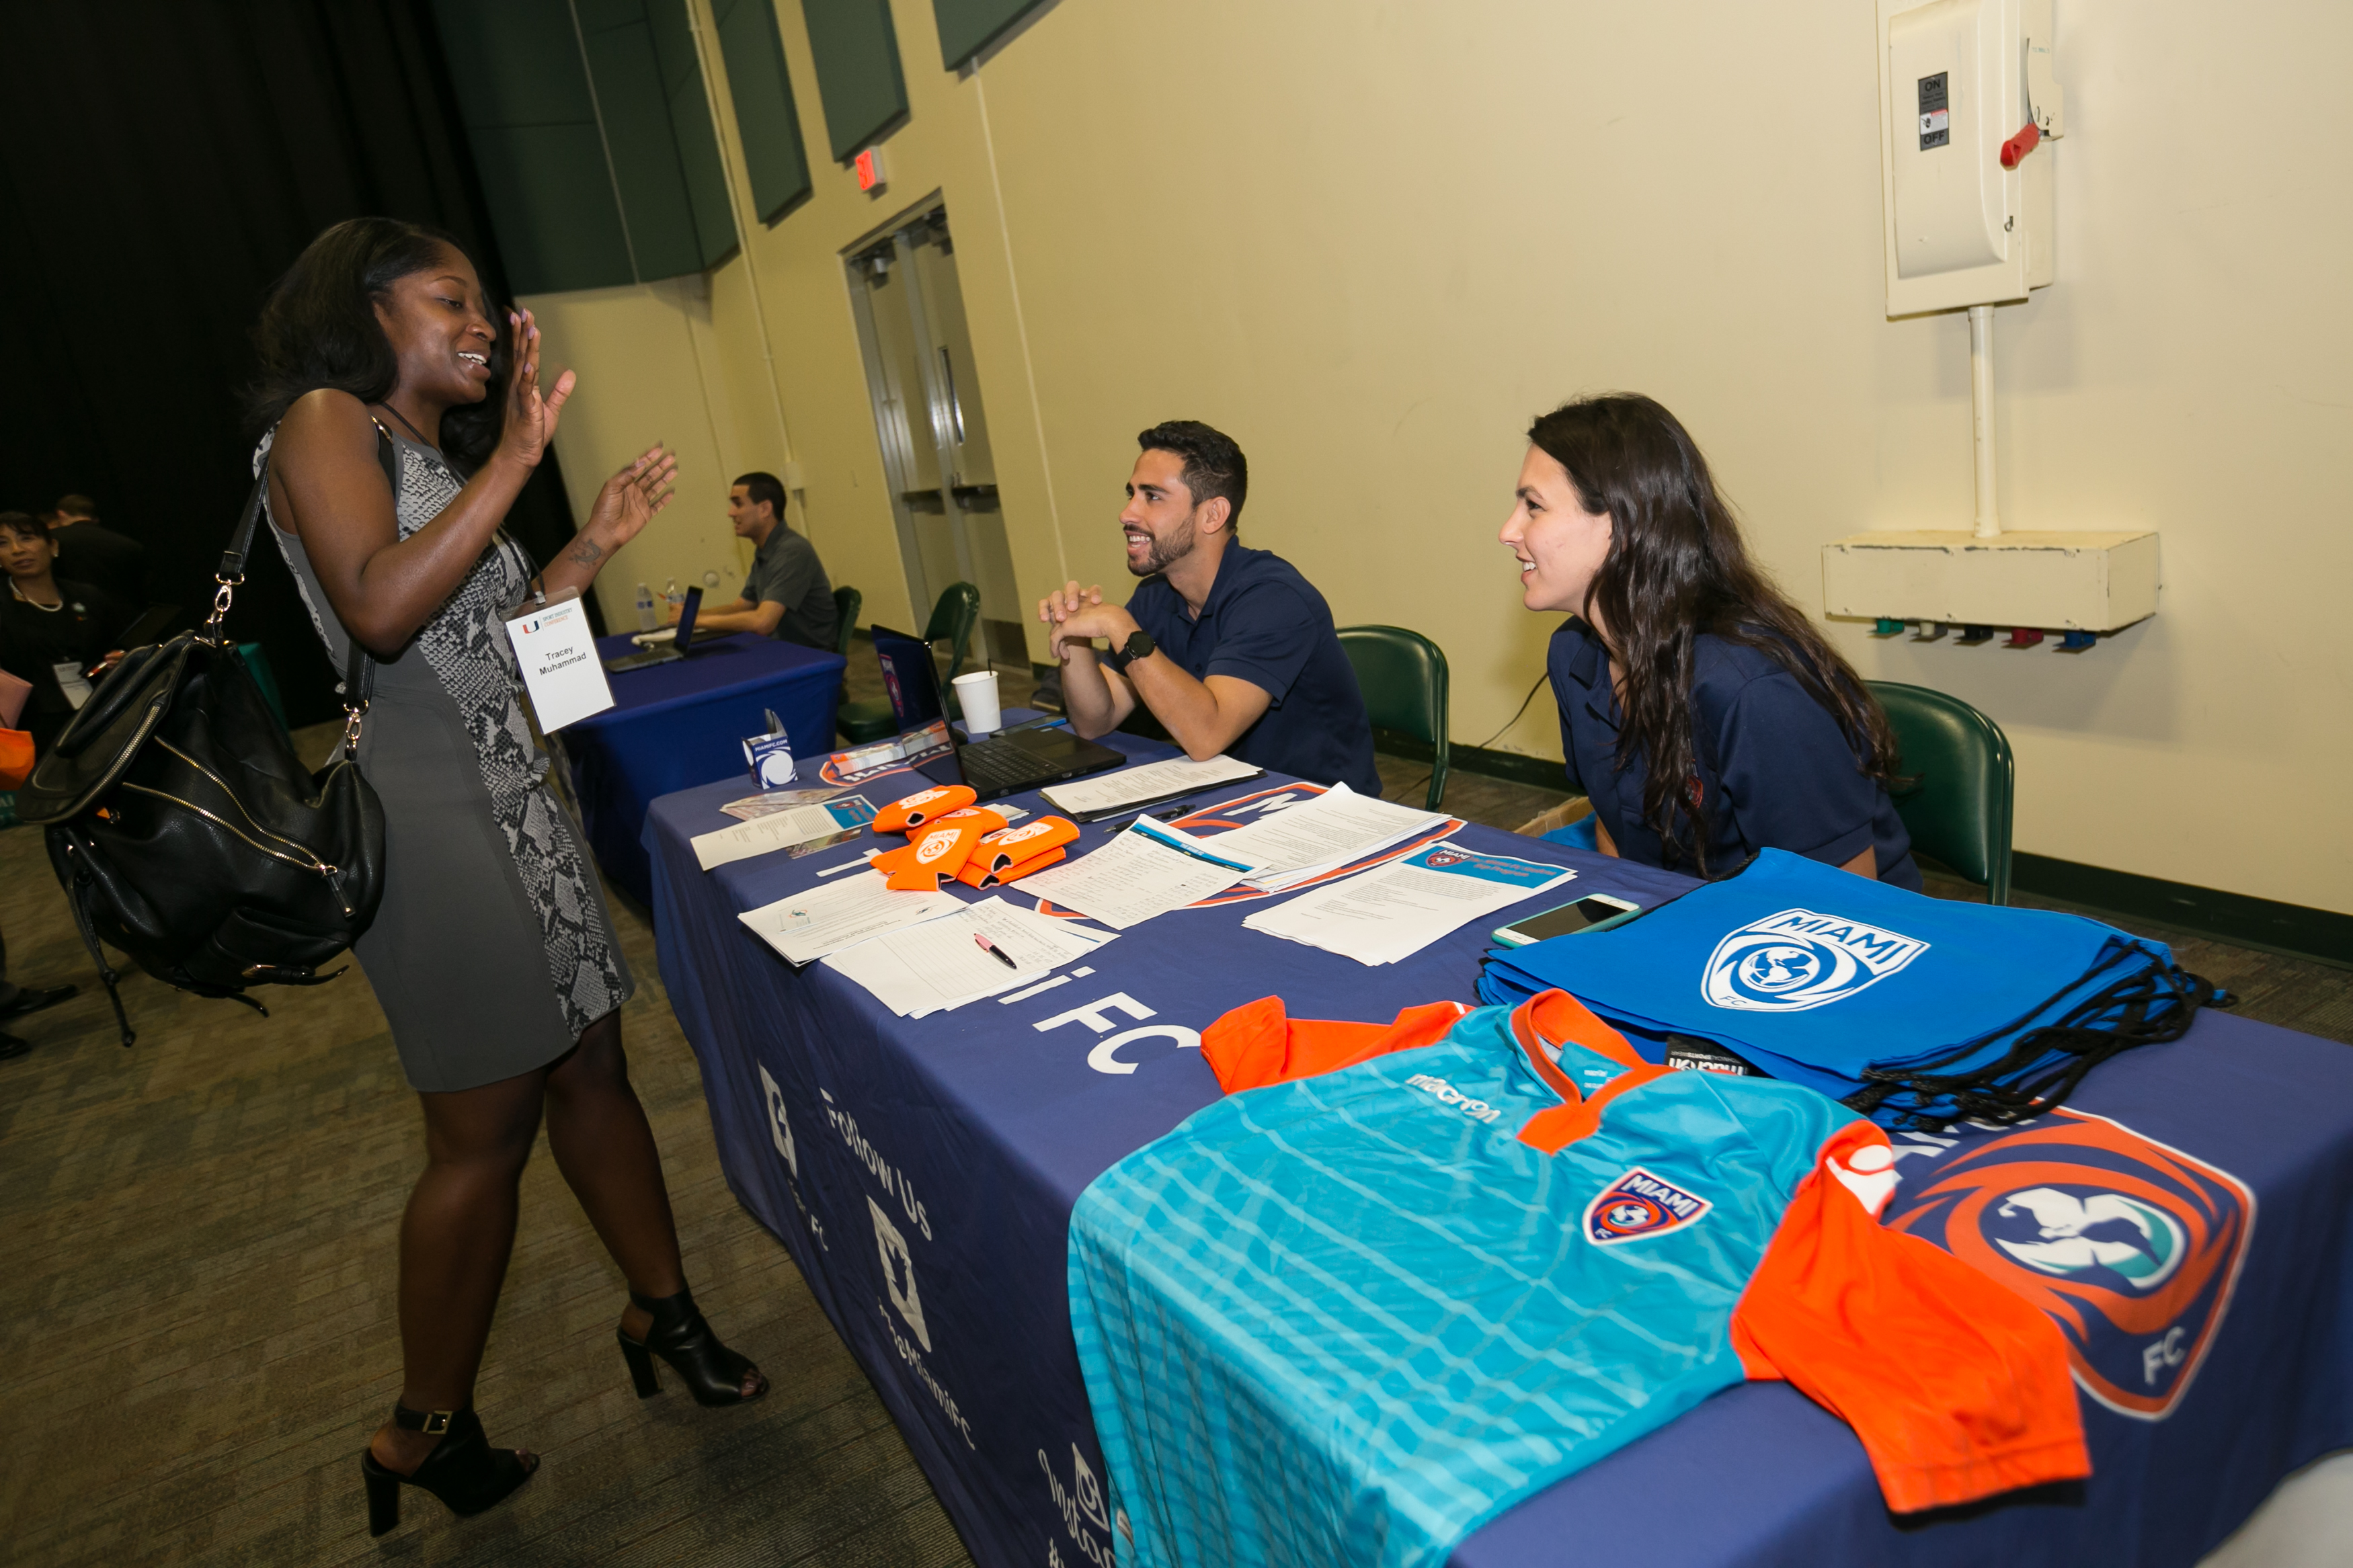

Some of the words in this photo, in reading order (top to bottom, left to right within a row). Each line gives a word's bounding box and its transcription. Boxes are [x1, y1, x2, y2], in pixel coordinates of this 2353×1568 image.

[1925, 79, 1941, 91] ON
[1924, 130, 1945, 144] OFF
[543, 614, 554, 622] SPORT
[555, 608, 573, 617] INDUSTRY
[544, 615, 569, 627] CONFERENCE
[545, 646, 573, 661] Tracey
[539, 652, 587, 675] Muhammad
[755, 739, 788, 751] MIAMIFC.COM
[928, 831, 957, 842] MIAMI
[1439, 850, 1471, 860] MIAMI
[1769, 915, 1909, 964] MIAMI
[1719, 995, 1749, 1007] FC
[1032, 991, 1201, 1075] FC
[1404, 1073, 1501, 1124] macron
[820, 1087, 894, 1197] Follow
[896, 1167, 932, 1241] Us
[1620, 1174, 1700, 1218] MIAMI
[1594, 1227, 1613, 1239] FC
[2142, 1326, 2186, 1386] FC
